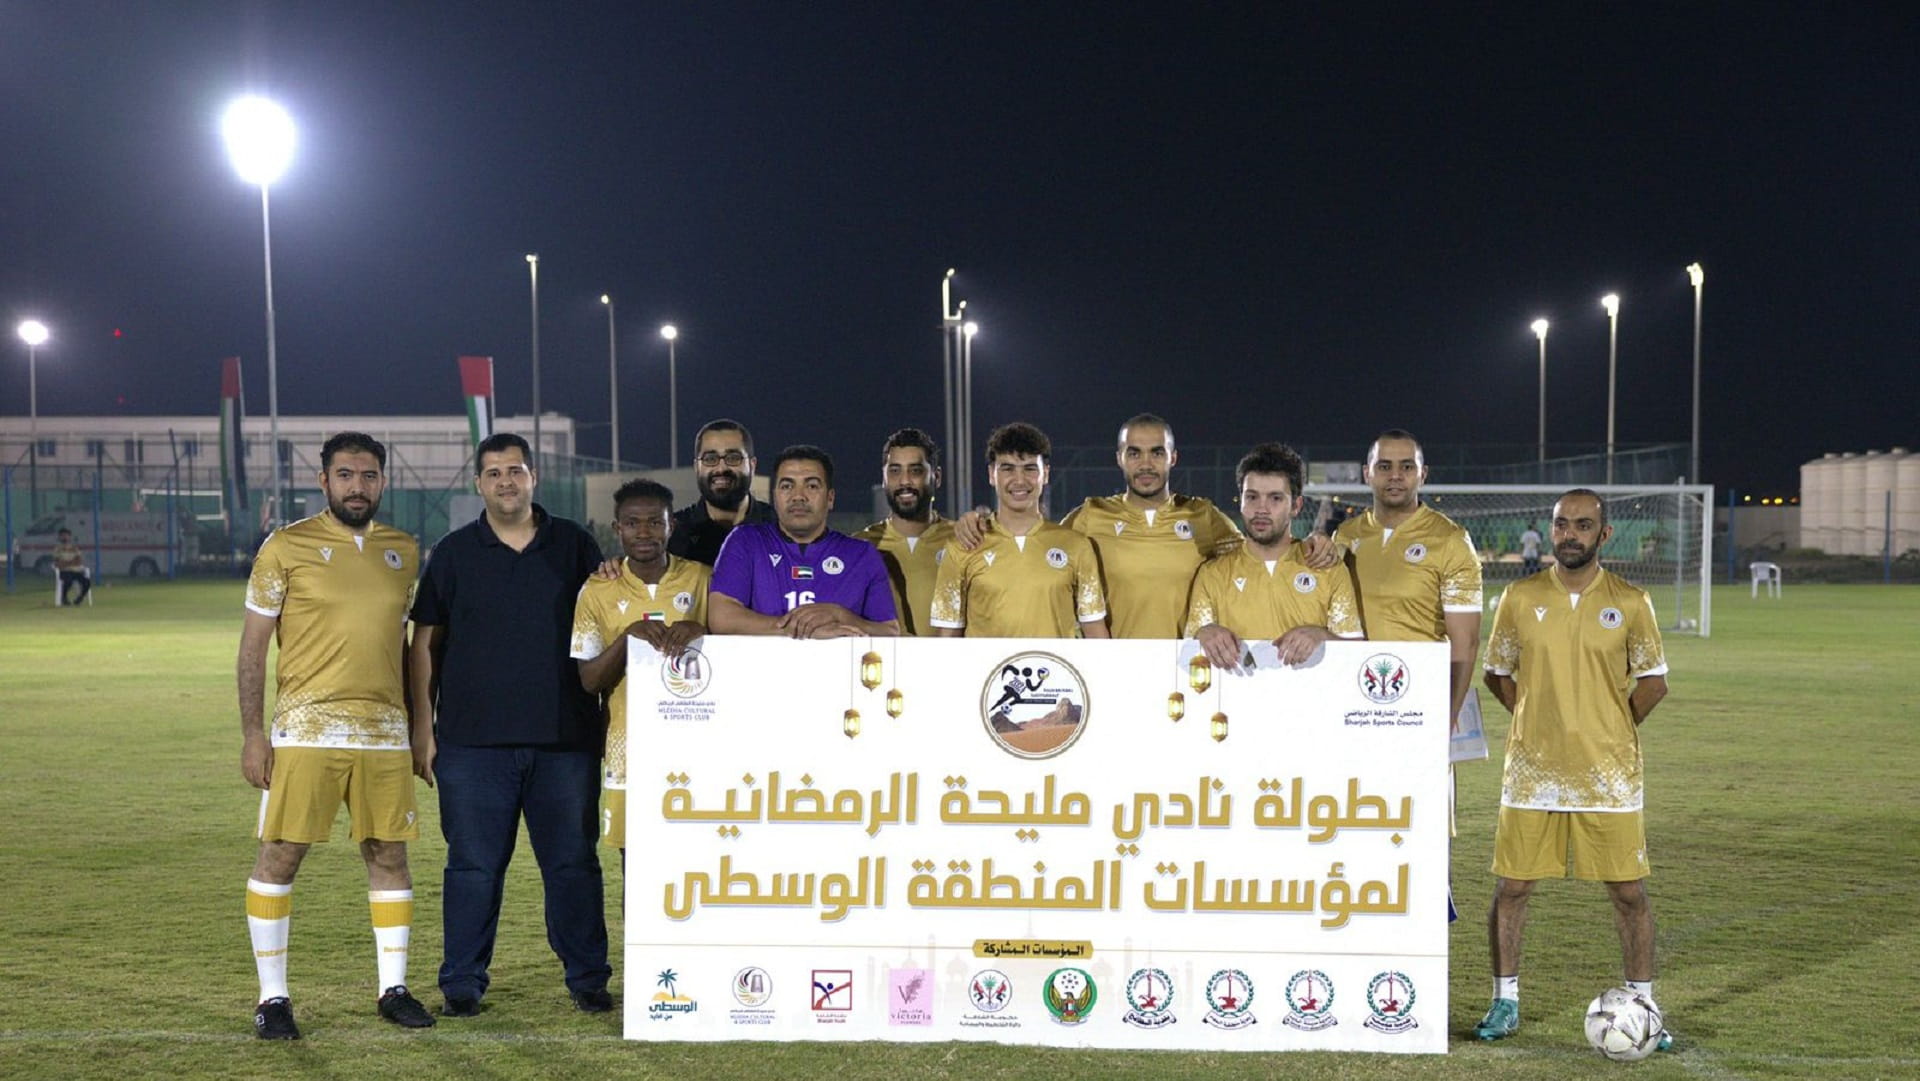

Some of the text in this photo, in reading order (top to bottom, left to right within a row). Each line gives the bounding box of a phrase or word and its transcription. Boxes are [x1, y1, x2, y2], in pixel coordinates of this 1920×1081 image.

[784, 591, 816, 610] 16
[1374, 709, 1398, 718] الشارقة
[1400, 710, 1423, 718] مجلس
[1344, 719, 1371, 727] Sharjah
[1373, 718, 1395, 726] Sports
[662, 771, 1412, 856] بطولة نادي مليحة الرمضانية
[664, 854, 1409, 928] لمؤسسات المنطقة الوسطى
[983, 940, 1084, 958] المؤسسات المشاركة
[649, 1000, 697, 1013] الوسطى
[891, 1012, 932, 1020] victoria
